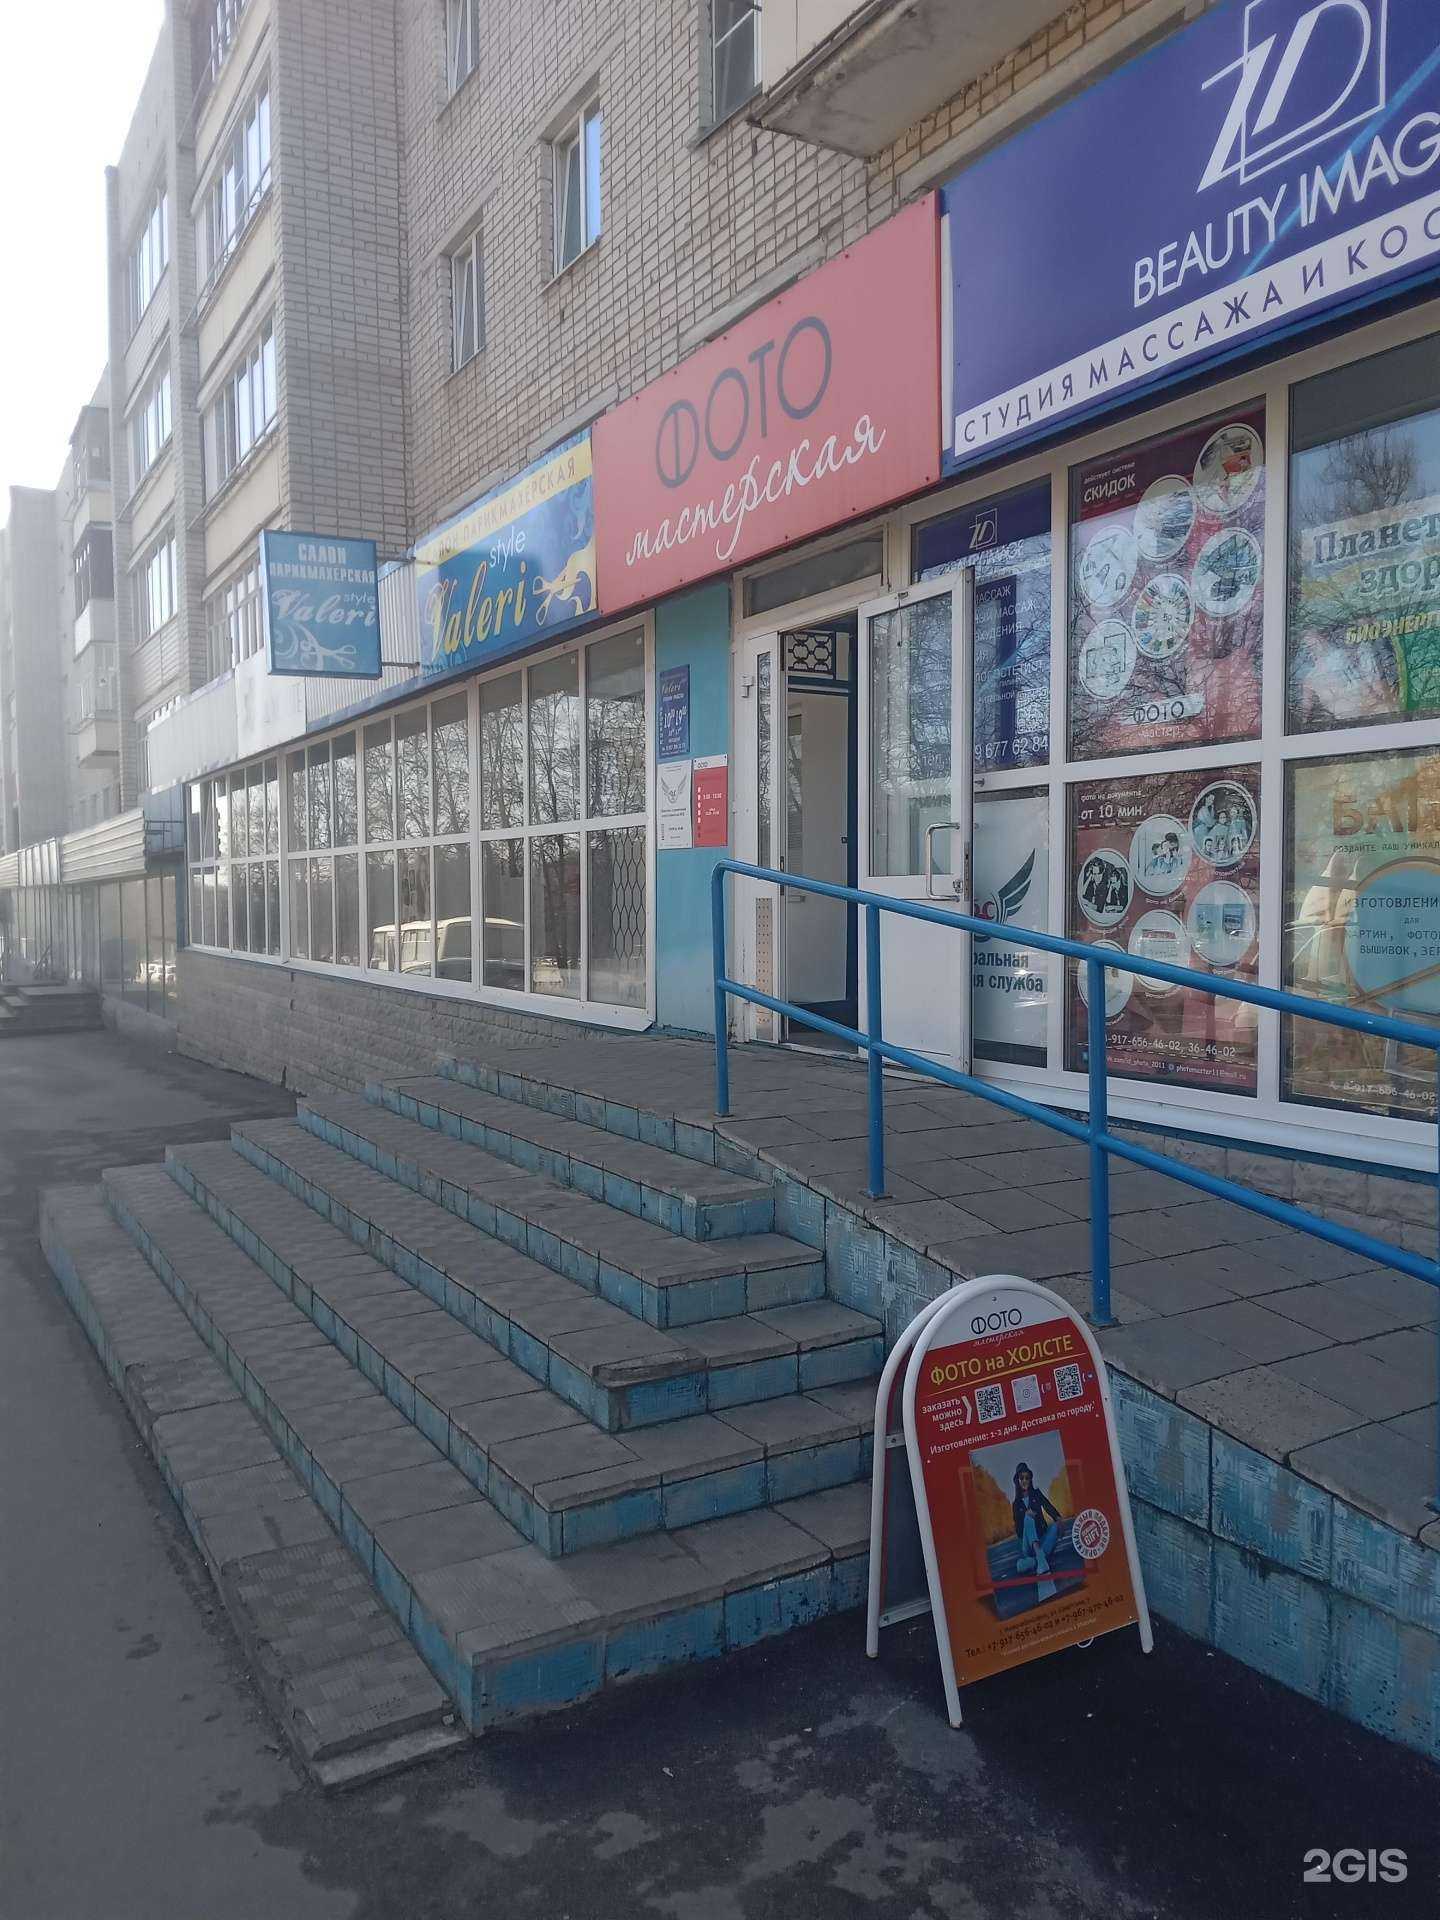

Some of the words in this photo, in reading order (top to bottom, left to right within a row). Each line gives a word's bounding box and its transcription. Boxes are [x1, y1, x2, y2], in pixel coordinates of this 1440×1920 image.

[1134, 184, 1287, 308] BEAUTY
[963, 373, 1074, 444] СТУДИЯ
[1089, 280, 1284, 391] МАССАЖА
[1302, 257, 1326, 296] И
[656, 316, 832, 489] ФОТО
[626, 414, 886, 566] мастерская
[1084, 473, 1136, 503] СКИДОК
[298, 543, 346, 565] САЛОН
[489, 526, 527, 572] style
[269, 562, 375, 584] ПАРИКМАХЕРСКАЯ
[271, 589, 376, 627] Valeri
[425, 561, 528, 661] Valeri
[985, 741, 1008, 759] 677
[1032, 735, 1049, 752] 84
[1081, 808, 1094, 820] от
[1099, 804, 1113, 818] 10
[1118, 805, 1146, 818] мин.
[989, 973, 1044, 993] служба
[1188, 1042, 1236, 1057] 36-46-02
[971, 1308, 1022, 1335] ФОТО
[931, 1358, 982, 1386] ФОТО
[986, 1355, 1005, 1372] на
[1007, 1335, 1074, 1365] ХОЛСТЕ
[922, 1397, 961, 1414] заказать
[932, 1408, 962, 1423] можно
[930, 1433, 989, 1455] Изготовление:
[1003, 1424, 1020, 1437] дня.
[1021, 1415, 1056, 1432] Доставка
[1057, 1411, 1066, 1420] по
[939, 1418, 964, 1433] здесь
